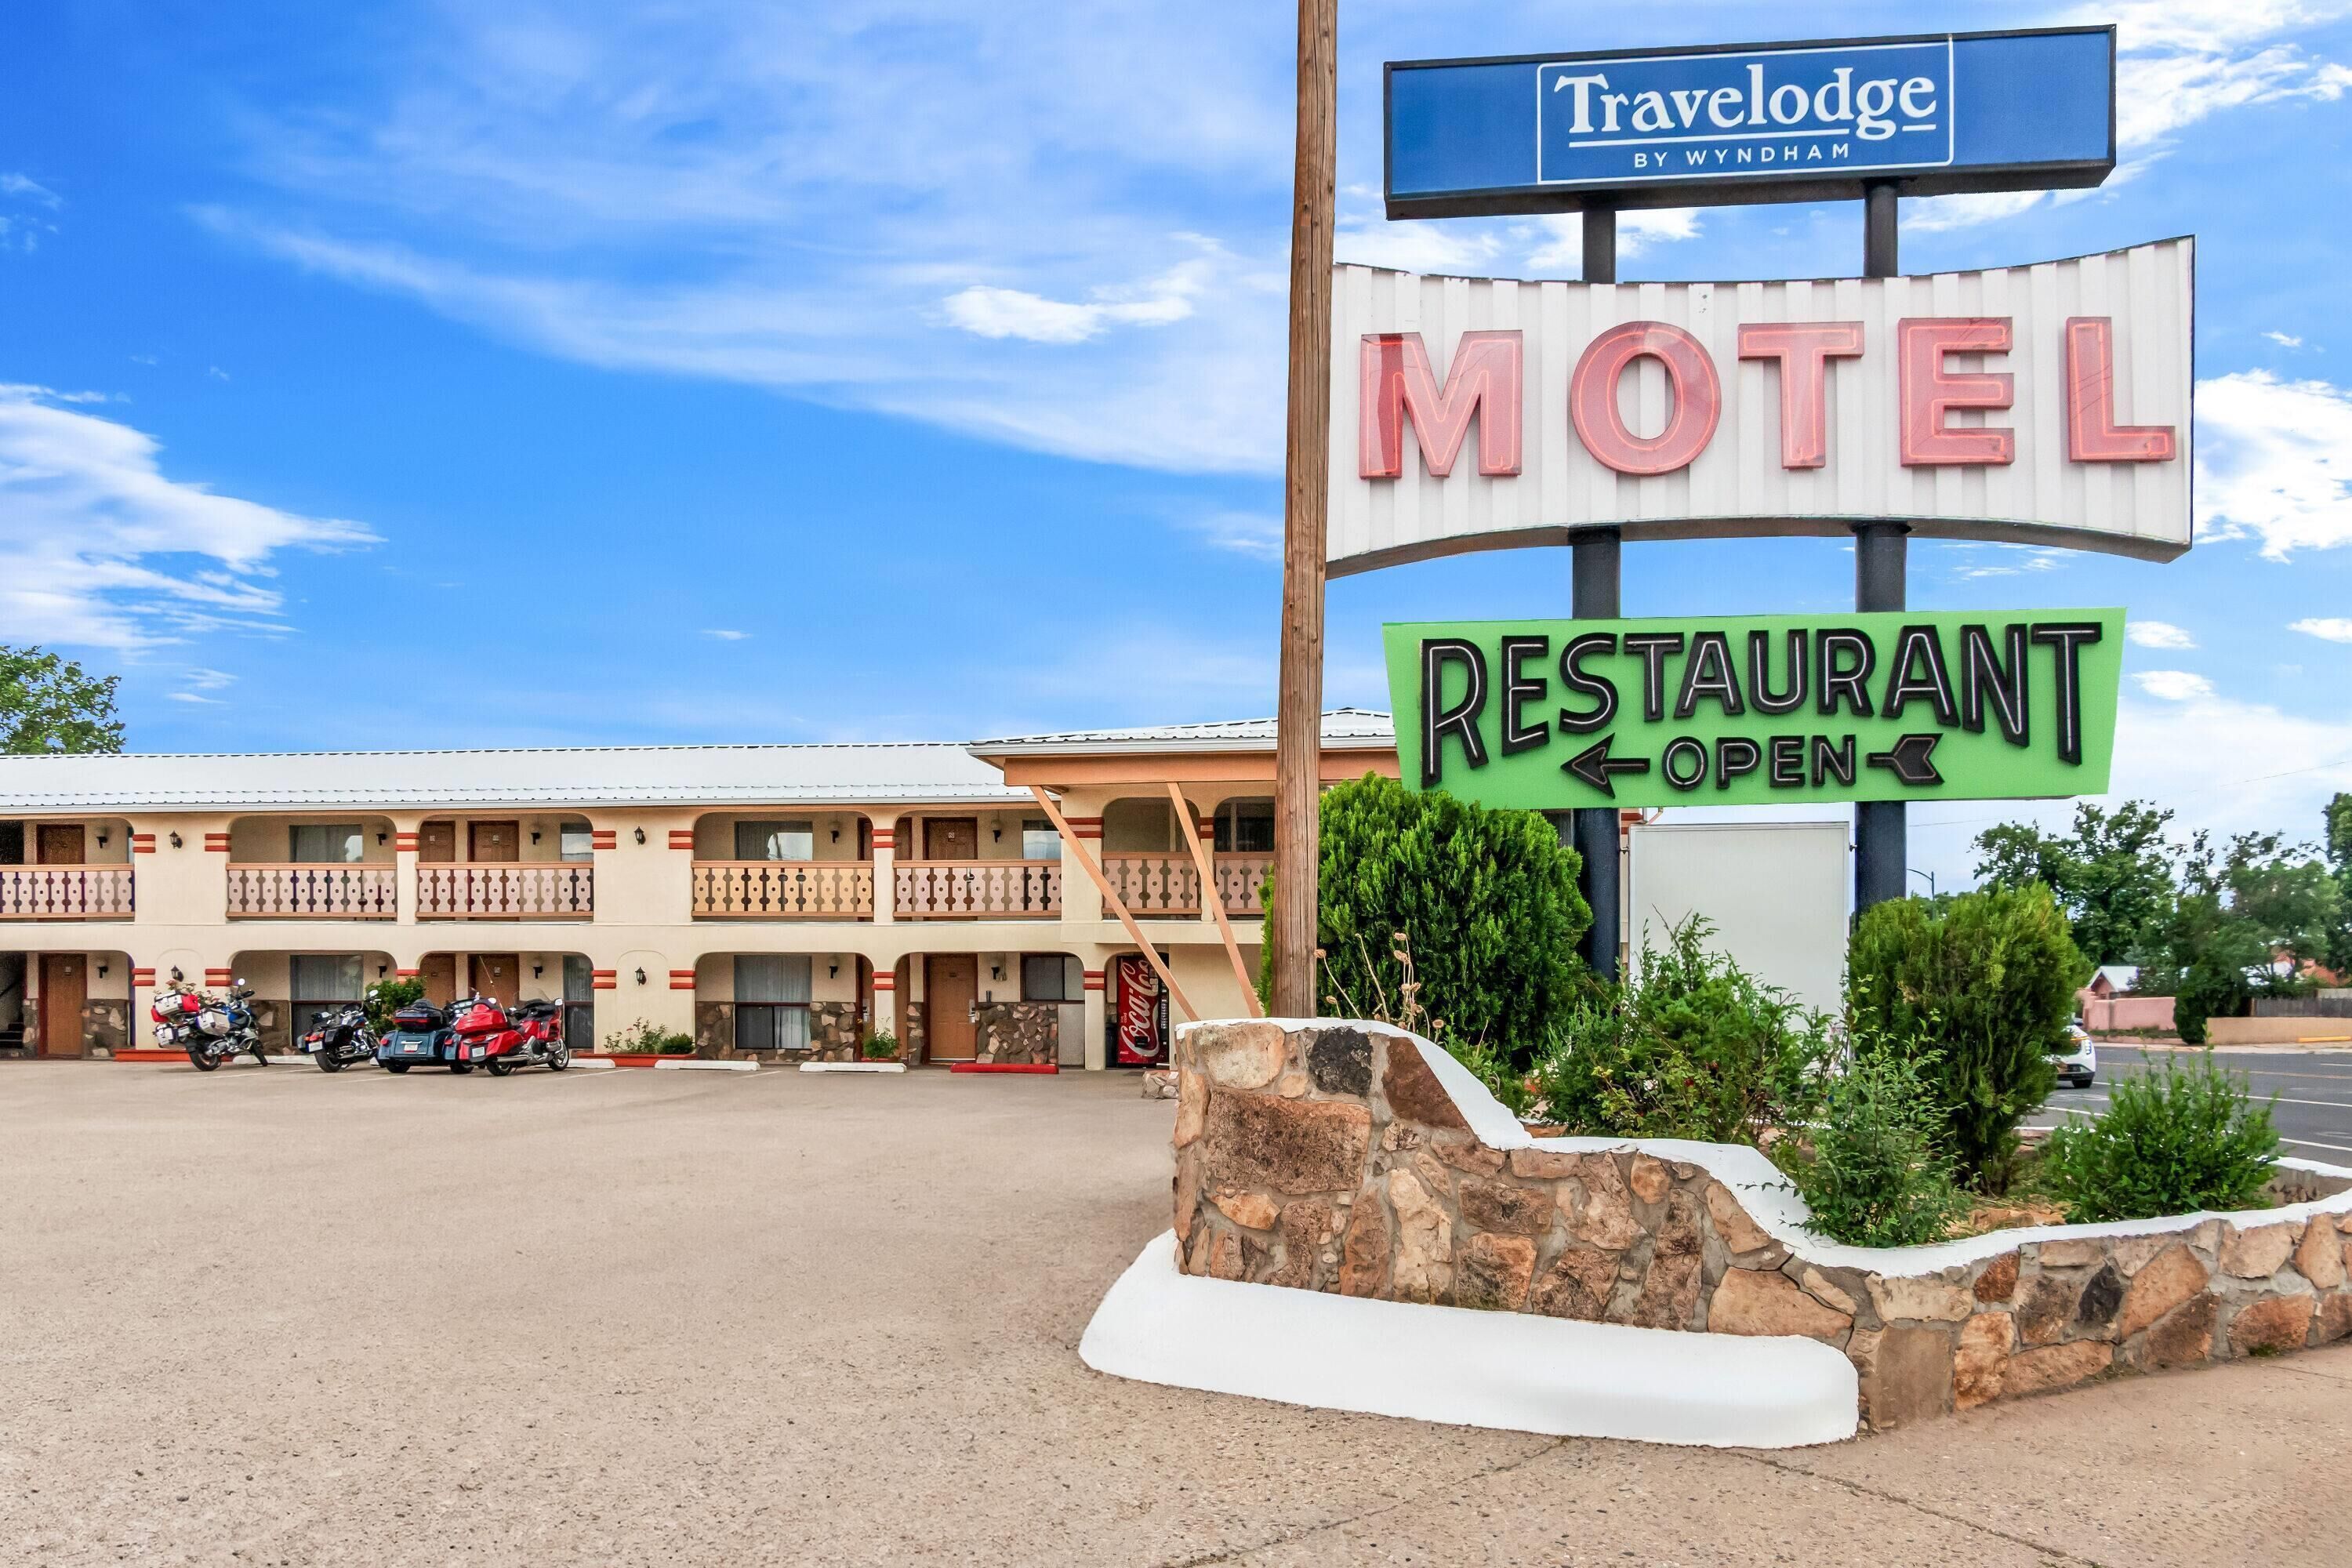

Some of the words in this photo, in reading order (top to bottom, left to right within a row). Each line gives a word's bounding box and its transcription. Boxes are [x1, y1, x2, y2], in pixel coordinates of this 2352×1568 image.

[1554, 64, 1937, 140] Travelodge
[1635, 153, 1667, 168] BY
[1686, 143, 1848, 165] WYNDHAM
[1358, 317, 2177, 481] MOTEL
[1420, 622, 2103, 791] RESTAURANT
[1661, 734, 1857, 793] OPEN
[1120, 958, 1159, 1057] Coca-Co
